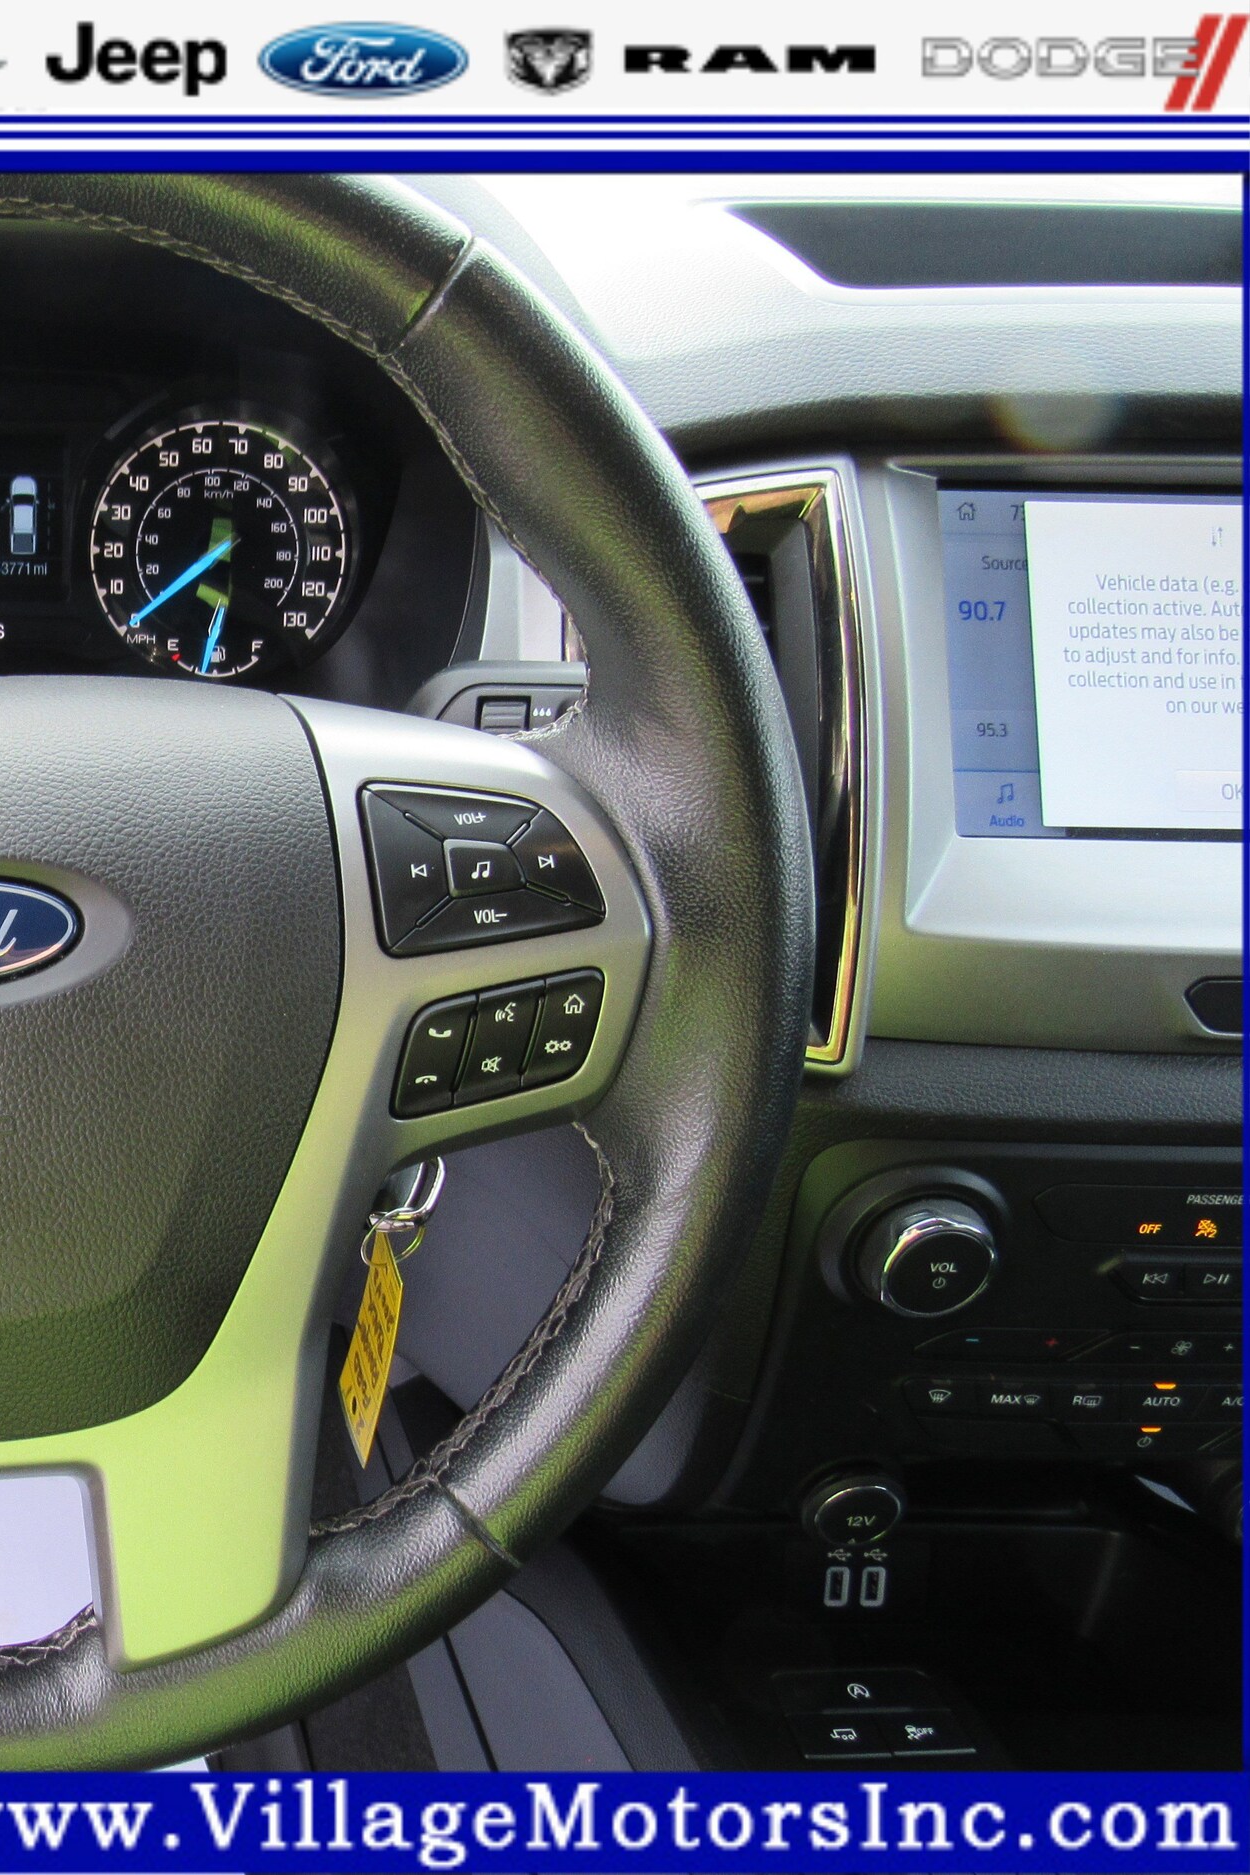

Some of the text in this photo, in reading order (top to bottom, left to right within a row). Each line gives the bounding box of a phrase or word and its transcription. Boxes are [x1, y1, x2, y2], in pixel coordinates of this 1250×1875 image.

[192, 439, 212, 453] 60
[229, 439, 247, 454] 70
[159, 452, 179, 467] 50
[264, 454, 283, 468] 80
[130, 476, 149, 491] 40
[204, 477, 220, 486] 100
[234, 481, 249, 491] 120
[288, 477, 307, 492] 90
[177, 488, 190, 498] 80
[204, 489, 233, 499] km/h
[256, 498, 272, 509] 140
[111, 505, 130, 520] 30
[157, 509, 171, 519] 60
[303, 509, 327, 523] 100
[271, 523, 286, 533] 160
[145, 535, 158, 545] 40
[104, 542, 123, 557] 20
[312, 546, 331, 560] 110
[276, 551, 291, 561] 180
[33, 563, 47, 575] mi
[146, 565, 159, 574] 20
[110, 579, 123, 594] 10
[264, 579, 282, 588] 200
[302, 582, 324, 596] 120
[1096, 574, 1239, 596] Vehicle data (e.g.
[958, 600, 1006, 621] 90.7
[1068, 598, 1243, 617] collection active. Aut
[283, 612, 306, 627] 130
[1069, 622, 1239, 643] updates may also be
[127, 634, 156, 644] MPH
[167, 639, 179, 651] E
[252, 640, 263, 652] F
[1063, 647, 1240, 666] to adjust and for info.
[1068, 671, 1235, 689] collection and use in
[1166, 700, 1186, 713] on
[1191, 700, 1217, 713] our
[976, 723, 1007, 737] 95.3
[989, 815, 1025, 827] Audio
[1139, 1224, 1162, 1234] OFF
[930, 1262, 957, 1273] VOL
[991, 1394, 1021, 1404] MAX
[1143, 1396, 1180, 1406] AUTO
[846, 1515, 876, 1527] 12V
